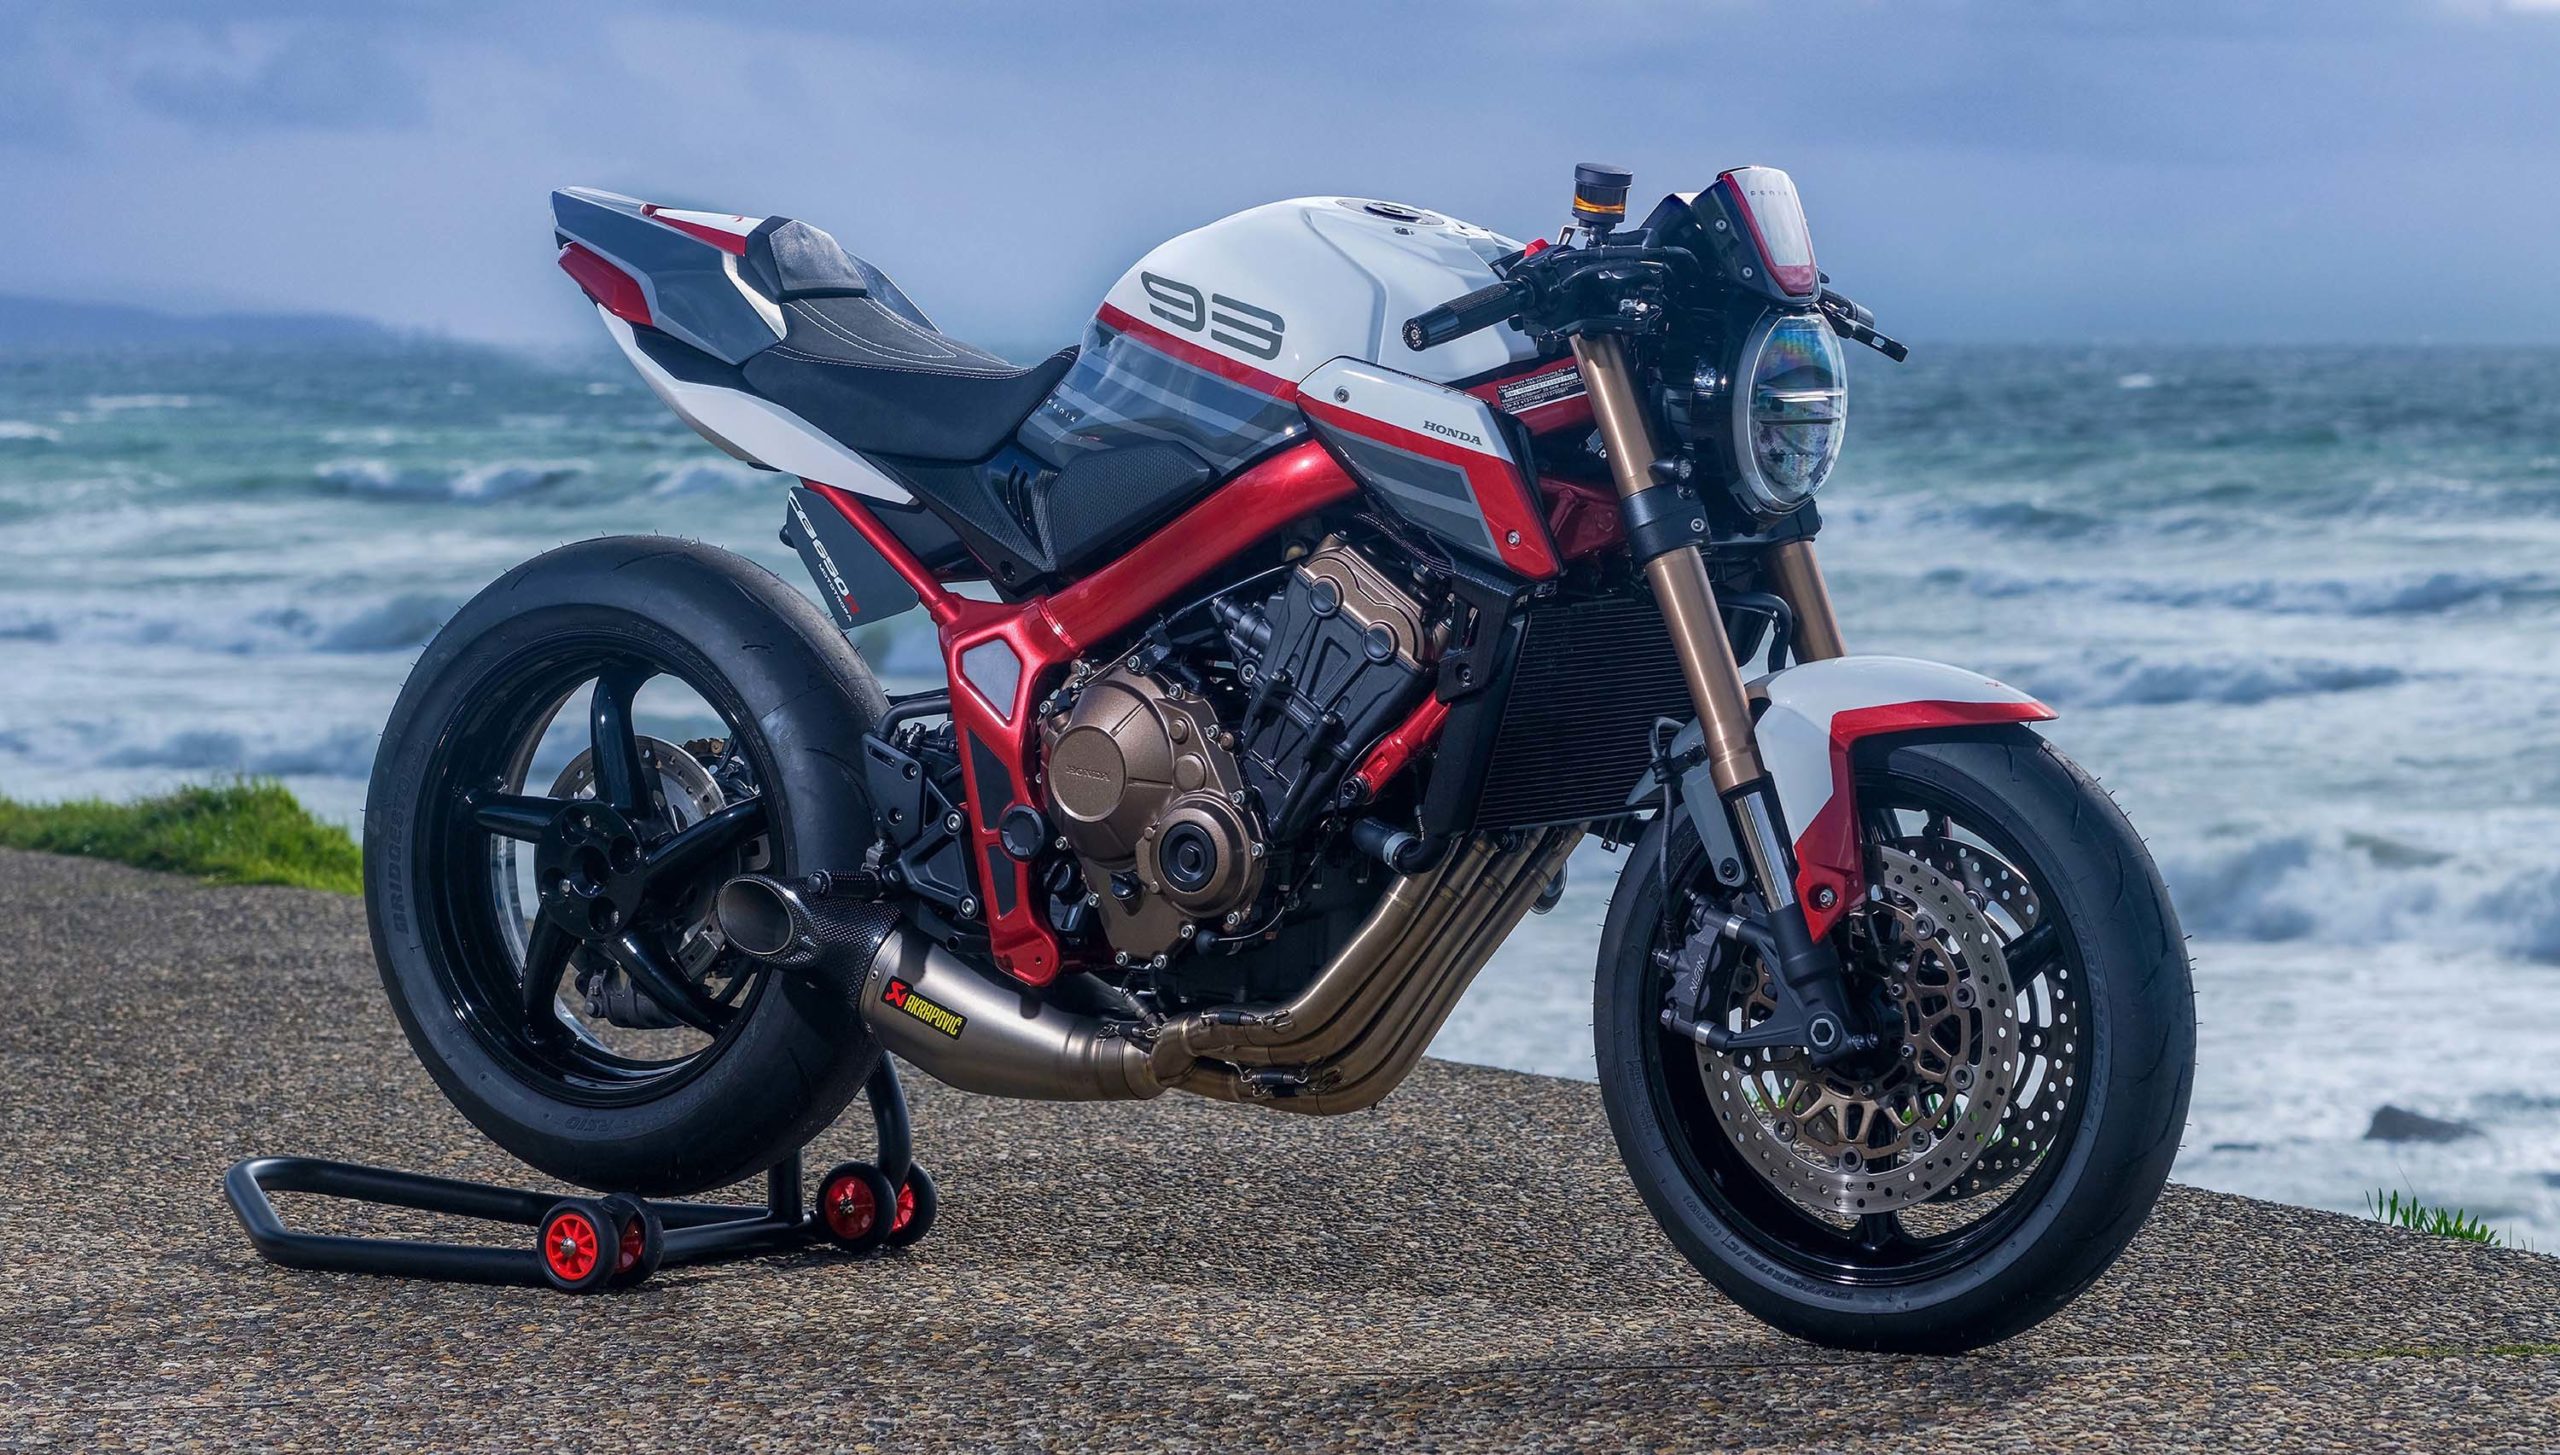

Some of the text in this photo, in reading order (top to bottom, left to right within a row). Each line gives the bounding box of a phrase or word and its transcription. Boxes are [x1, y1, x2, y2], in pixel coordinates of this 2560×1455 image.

[1141, 271, 1285, 361] 93
[1423, 420, 1482, 446] HONDA
[788, 490, 860, 614] CB650R
[1065, 765, 1111, 781] HONDA
